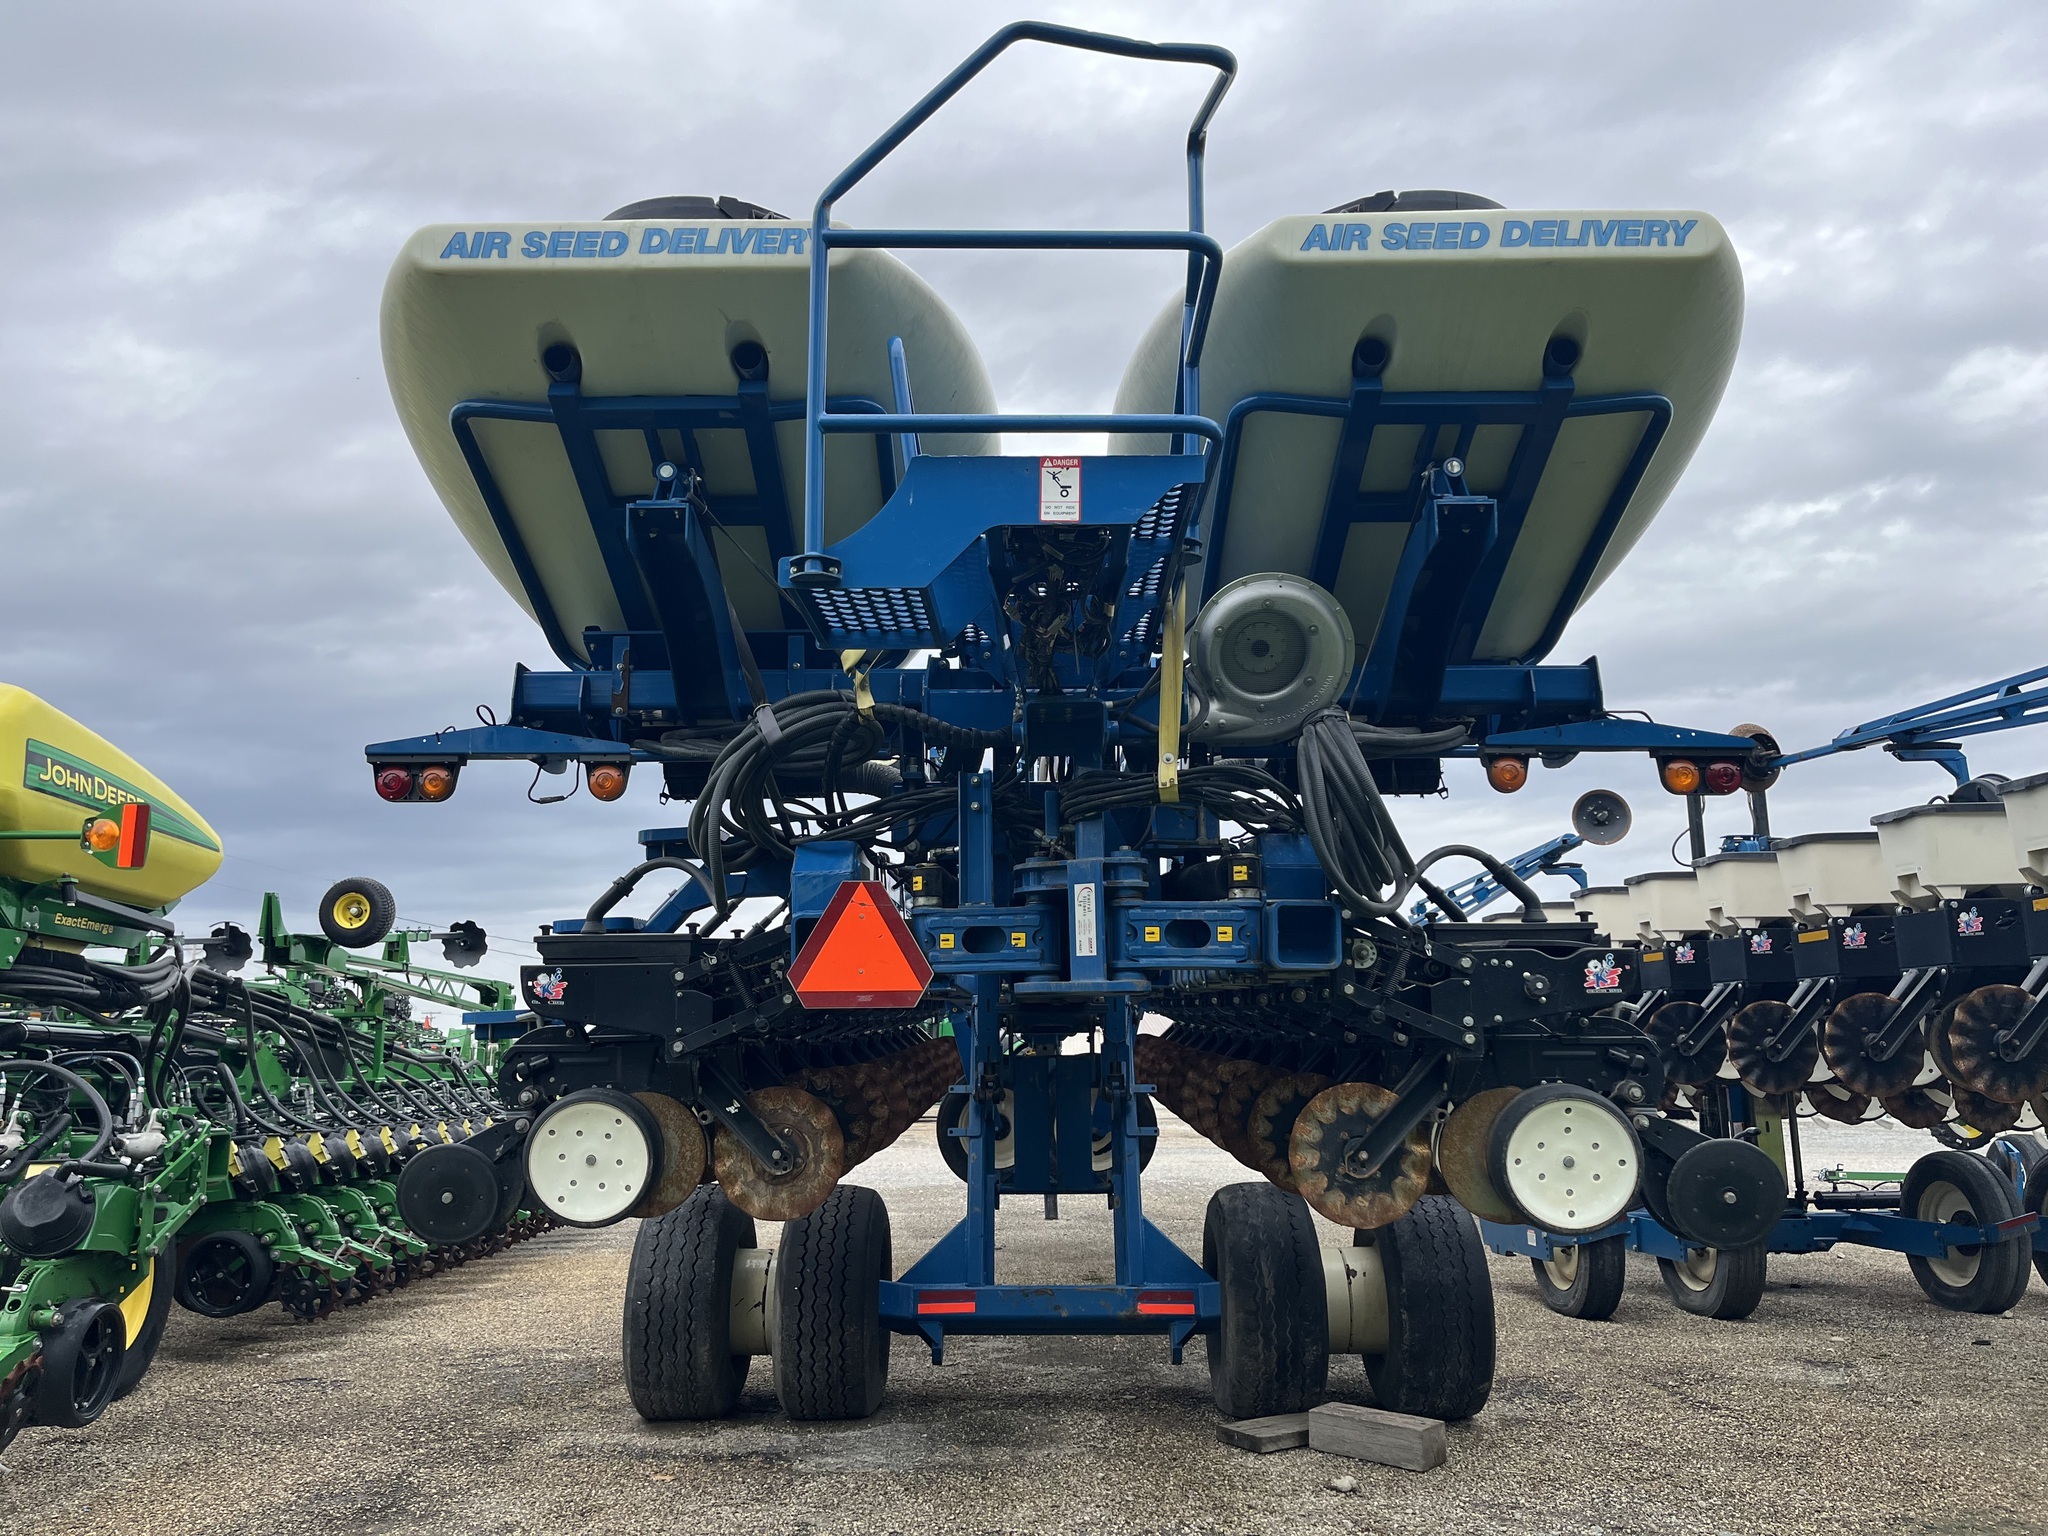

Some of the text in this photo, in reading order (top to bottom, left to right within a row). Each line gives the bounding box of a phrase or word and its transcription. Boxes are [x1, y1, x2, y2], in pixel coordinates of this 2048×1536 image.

[439, 227, 814, 259] AIR SEED DELIVER
[1300, 219, 1698, 251] AIR SEED DELIVERY
[1053, 458, 1079, 466] DANGER
[40, 757, 145, 805] JOHN DEE
[54, 912, 114, 934] ExactEmerge
